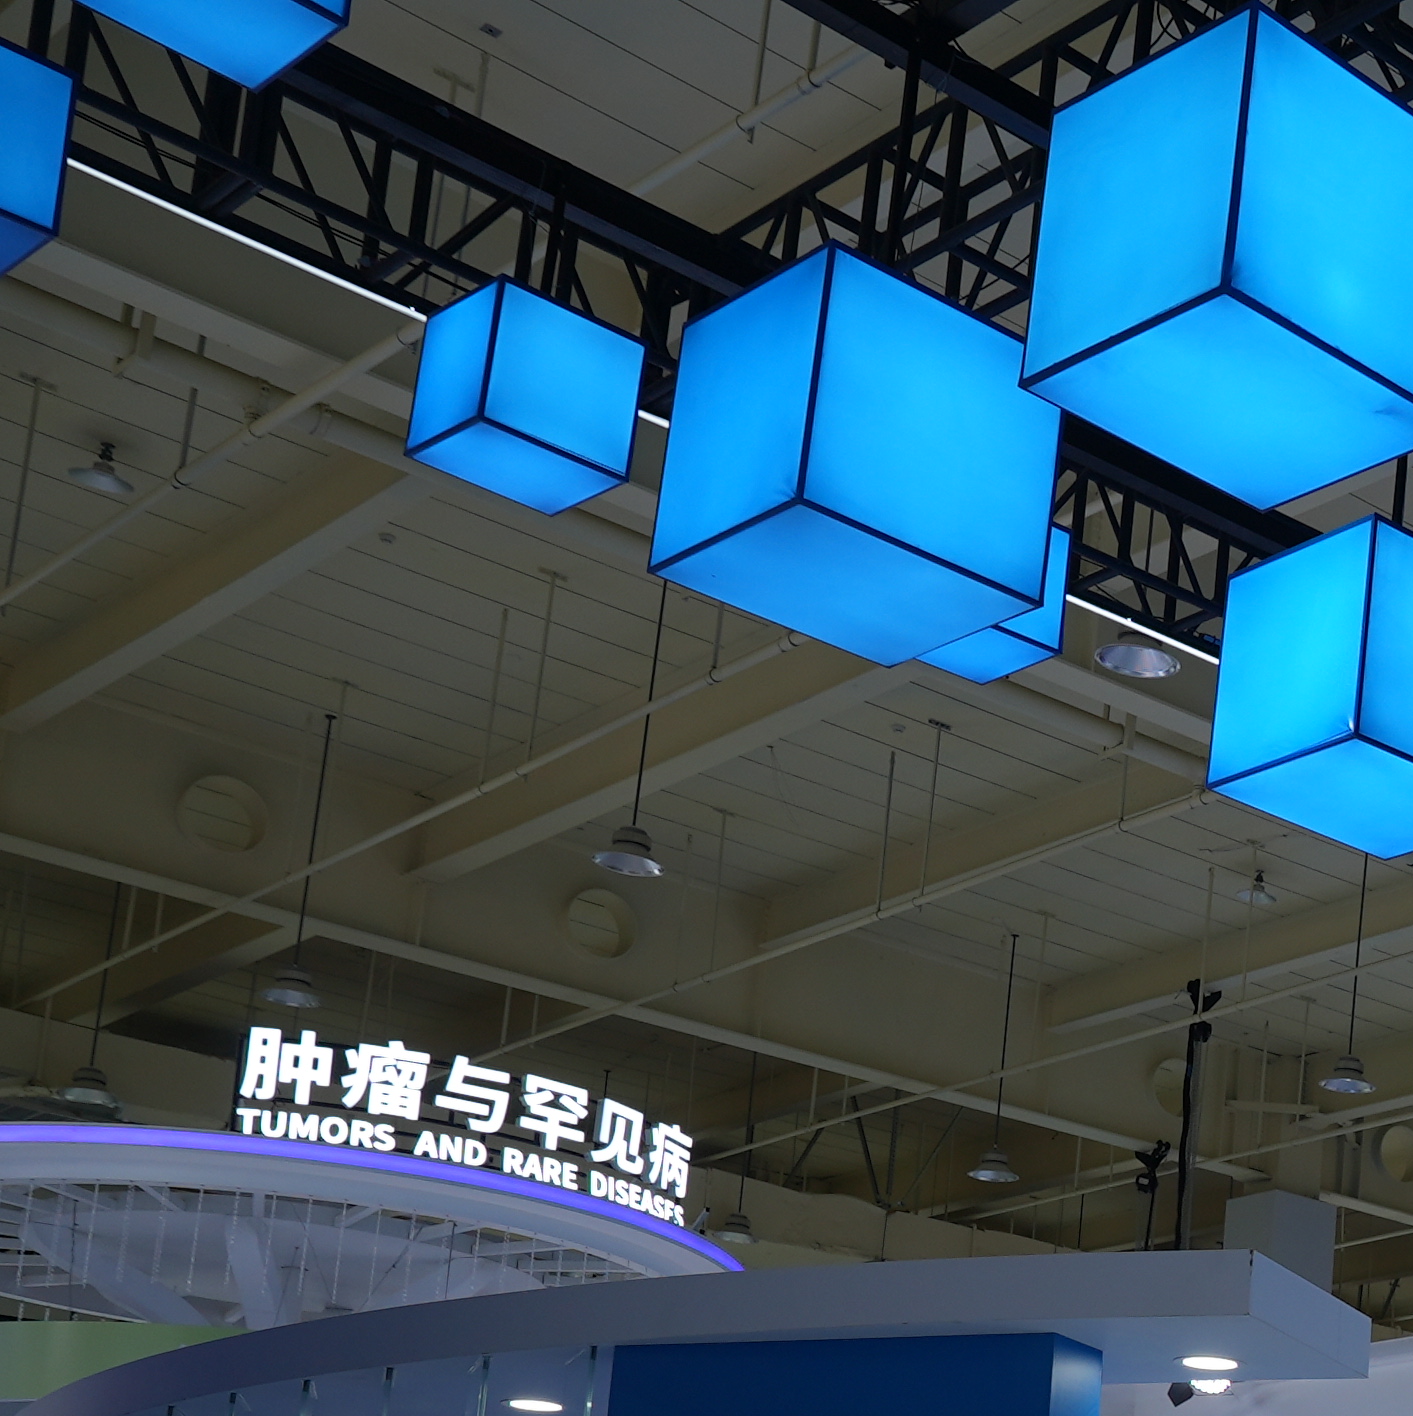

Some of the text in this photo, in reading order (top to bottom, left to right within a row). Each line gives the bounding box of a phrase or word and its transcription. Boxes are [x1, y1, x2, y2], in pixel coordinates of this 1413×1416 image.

[236, 1107, 396, 1152] TUMORS
[413, 1130, 487, 1167] AND
[502, 1147, 579, 1191] RARE
[239, 1026, 694, 1199] 肿瘤与罕见病
